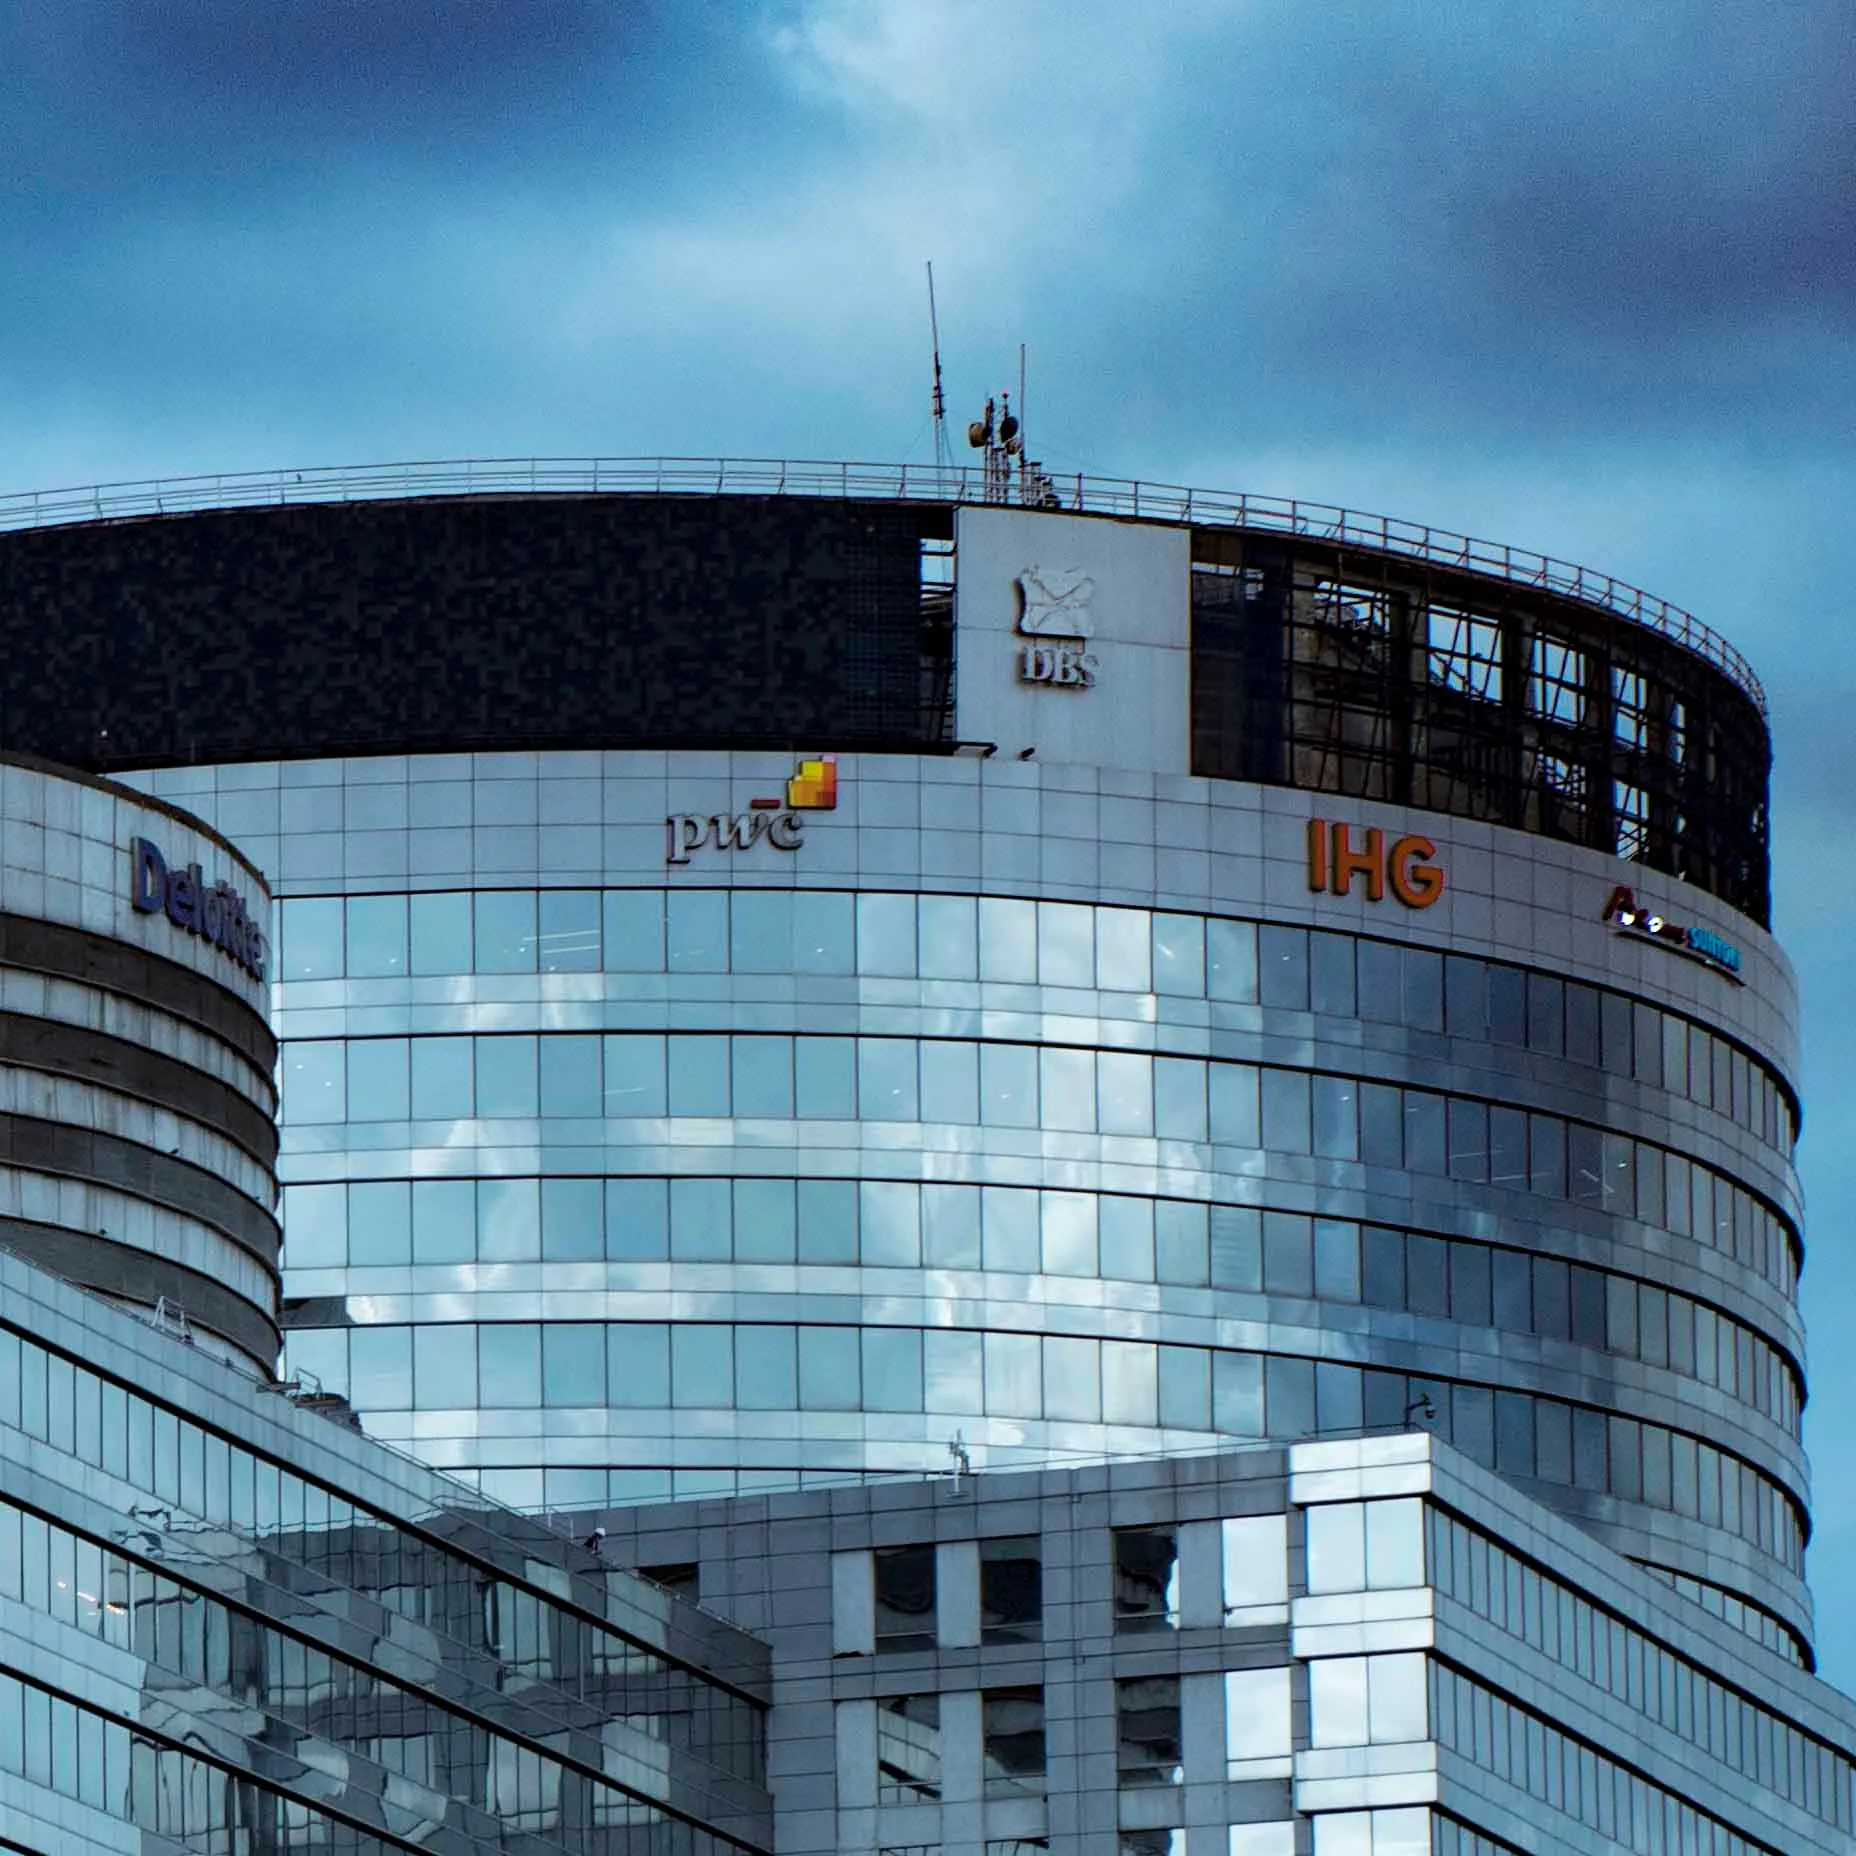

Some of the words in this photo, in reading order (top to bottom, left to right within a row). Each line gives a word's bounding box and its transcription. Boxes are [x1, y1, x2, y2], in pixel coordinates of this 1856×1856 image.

[1020, 646, 1100, 689] DBS
[665, 811, 805, 865] pwc
[1307, 816, 1445, 910] IHG
